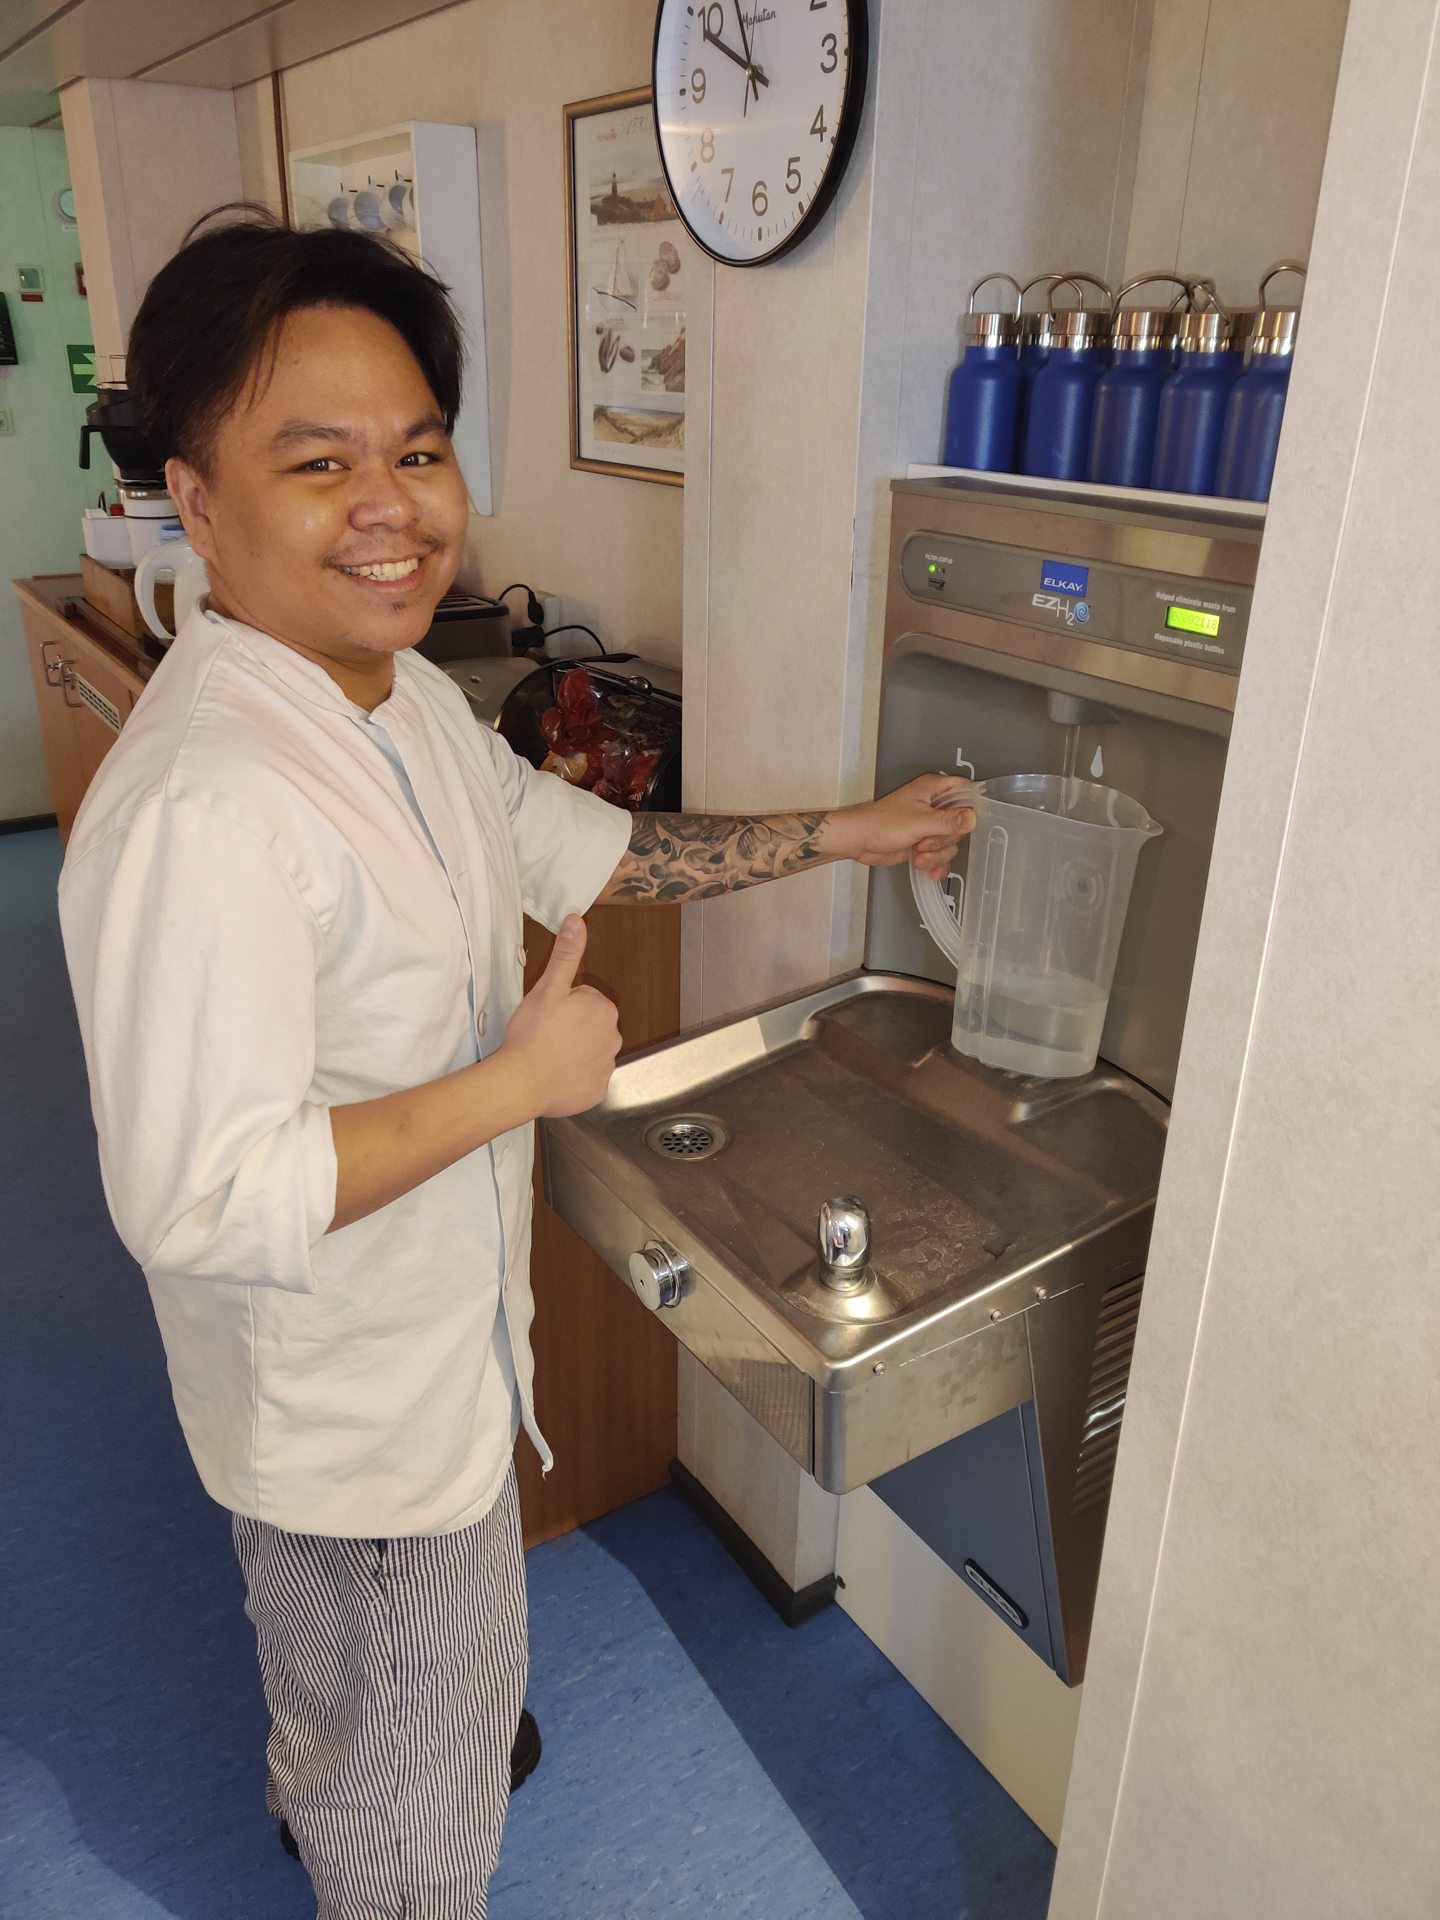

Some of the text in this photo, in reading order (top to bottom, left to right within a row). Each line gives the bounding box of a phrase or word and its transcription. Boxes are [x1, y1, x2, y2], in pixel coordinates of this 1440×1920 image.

[697, 2, 725, 42] 10
[742, 7, 777, 30] Manutan
[820, 33, 839, 74] 3
[690, 67, 707, 104] 9
[809, 104, 828, 143] 4
[700, 127, 716, 164] 8
[720, 167, 735, 204] 7
[785, 156, 802, 195] 5
[751, 180, 769, 217] 6
[1043, 577, 1084, 592] ELKAY
[1156, 591, 1236, 613] Helped eliminate waste from
[1153, 632, 1225, 655] disposable plastic bottles
[968, 1569, 1020, 1620] ELKAY
